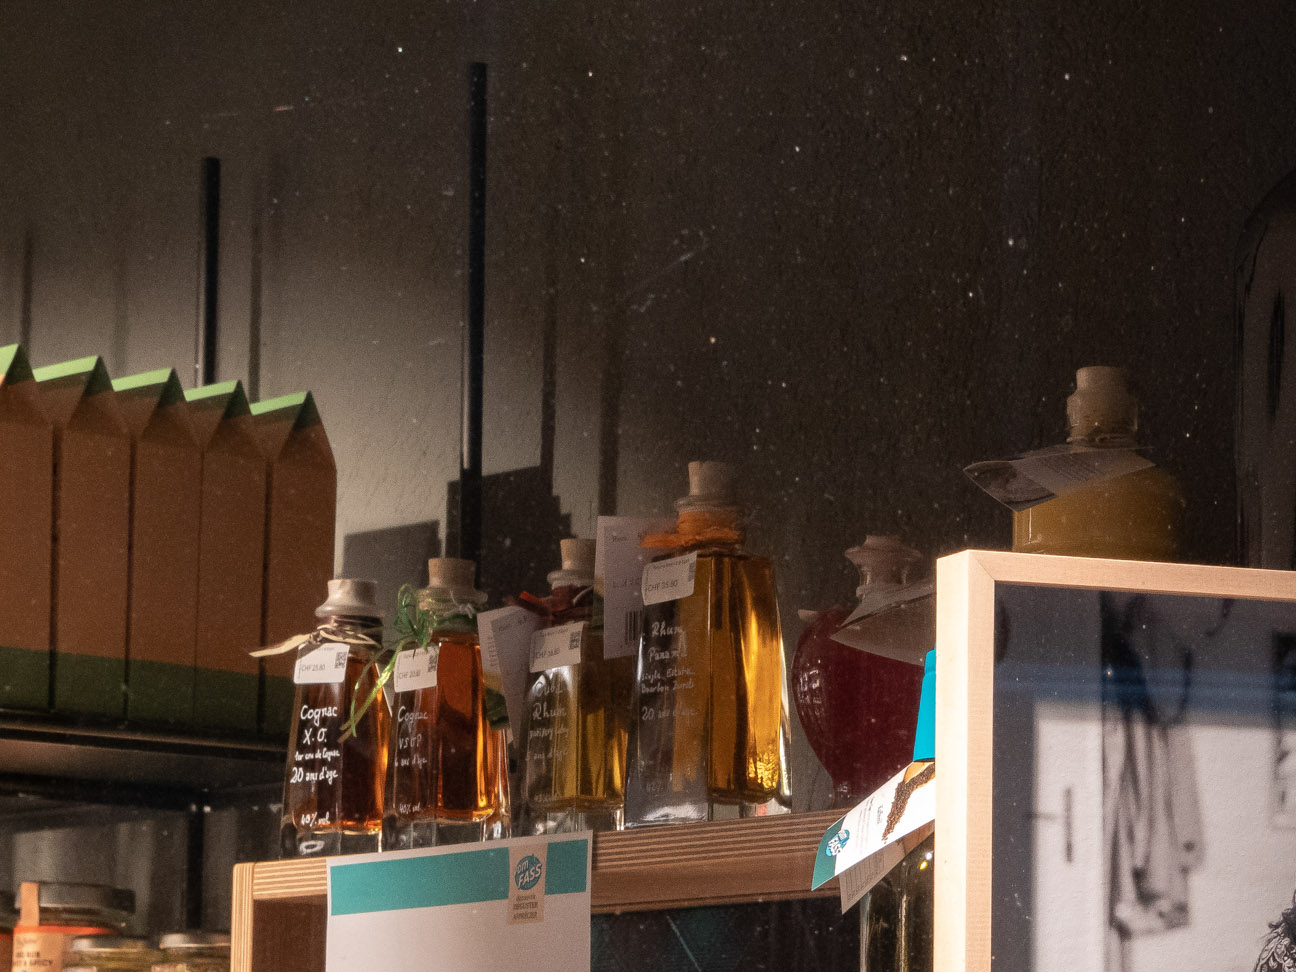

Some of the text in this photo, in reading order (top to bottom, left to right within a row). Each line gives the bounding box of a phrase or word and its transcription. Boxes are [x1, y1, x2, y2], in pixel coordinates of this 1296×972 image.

[300, 704, 339, 727] Cognac
[398, 705, 428, 732] Cognac
[641, 706, 655, 721] 20
[290, 767, 304, 783] 20
[517, 863, 543, 888] FASS
